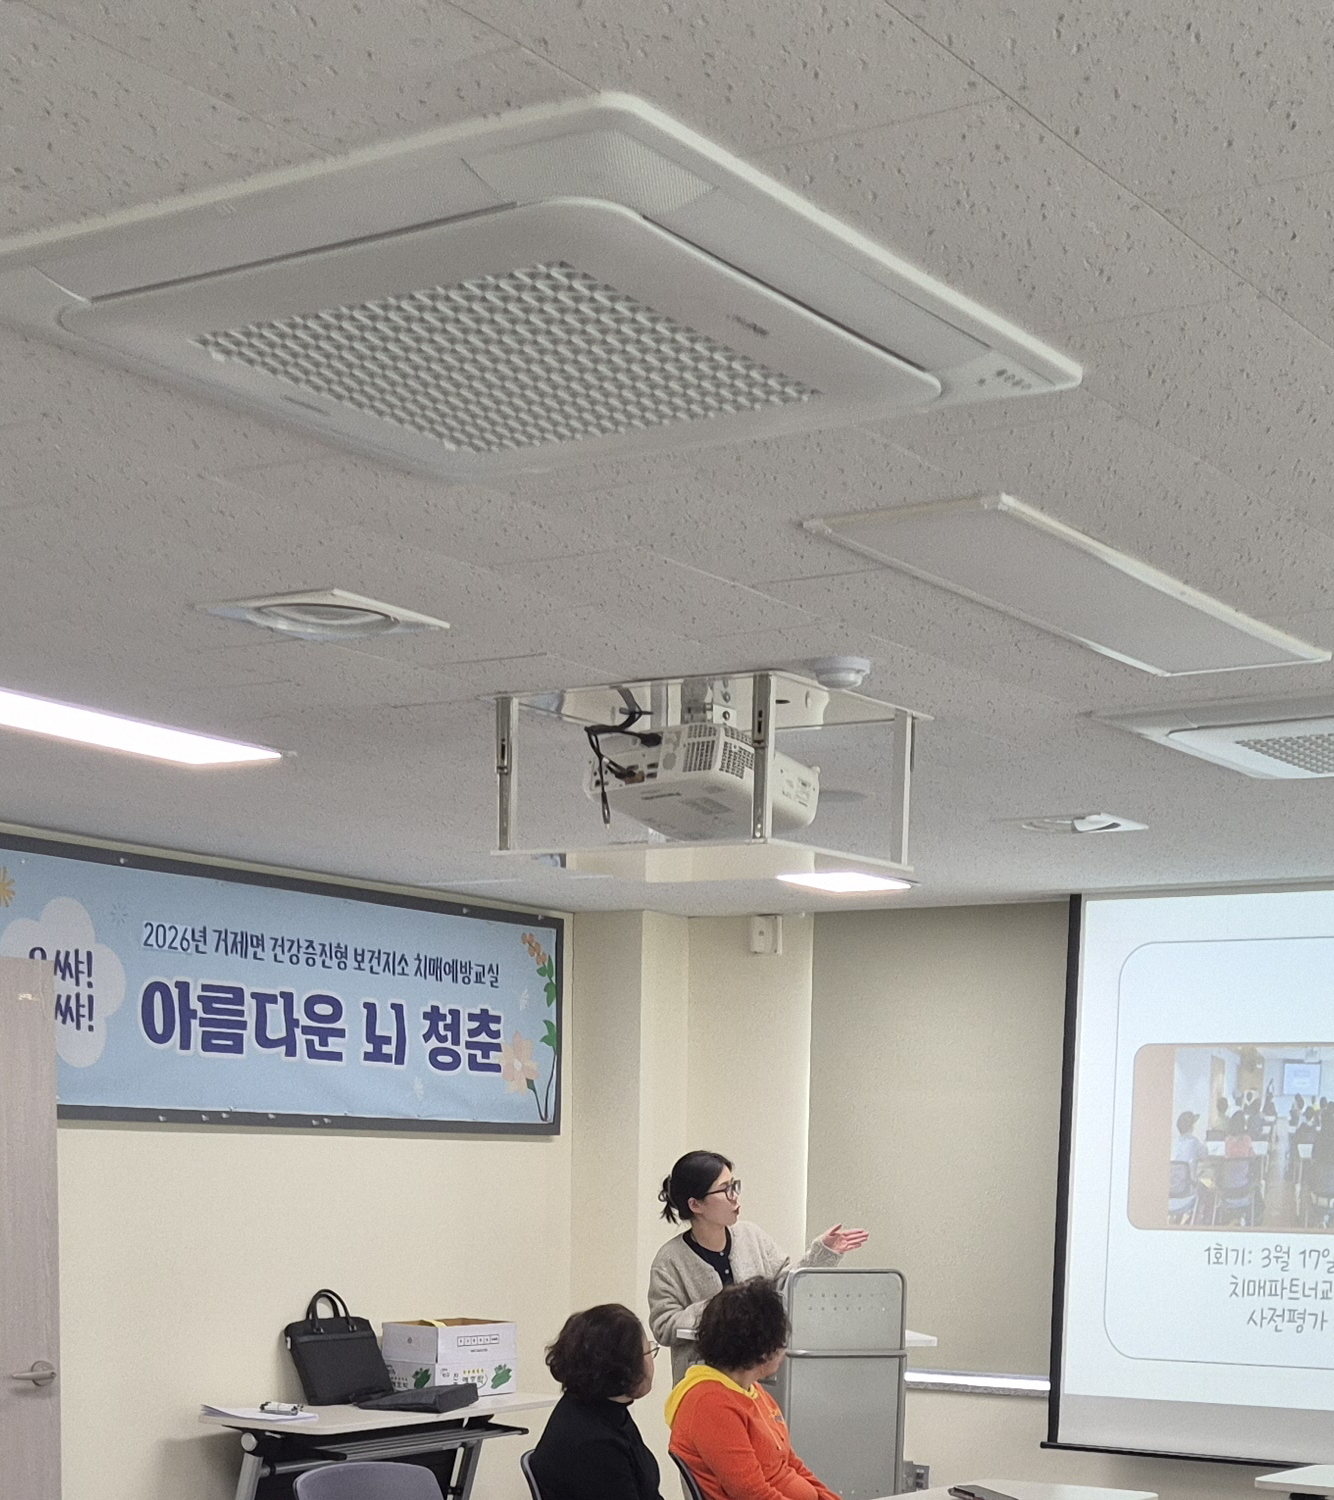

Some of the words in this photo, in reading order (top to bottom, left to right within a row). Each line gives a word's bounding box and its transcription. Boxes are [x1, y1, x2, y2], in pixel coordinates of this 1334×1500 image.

[143, 922, 207, 955] 2026년
[212, 929, 265, 961] 거제면
[270, 936, 348, 971] 건강증진형
[353, 947, 409, 978] 보건지소
[414, 953, 500, 989] 치매예방교실
[141, 980, 346, 1062] 아름다운
[363, 1001, 407, 1066] 뇌
[422, 1004, 502, 1073] 청춘
[1204, 1243, 1252, 1266] 1회기:
[1261, 1244, 1291, 1272] 3월
[1247, 1307, 1328, 1334] 사전평가
